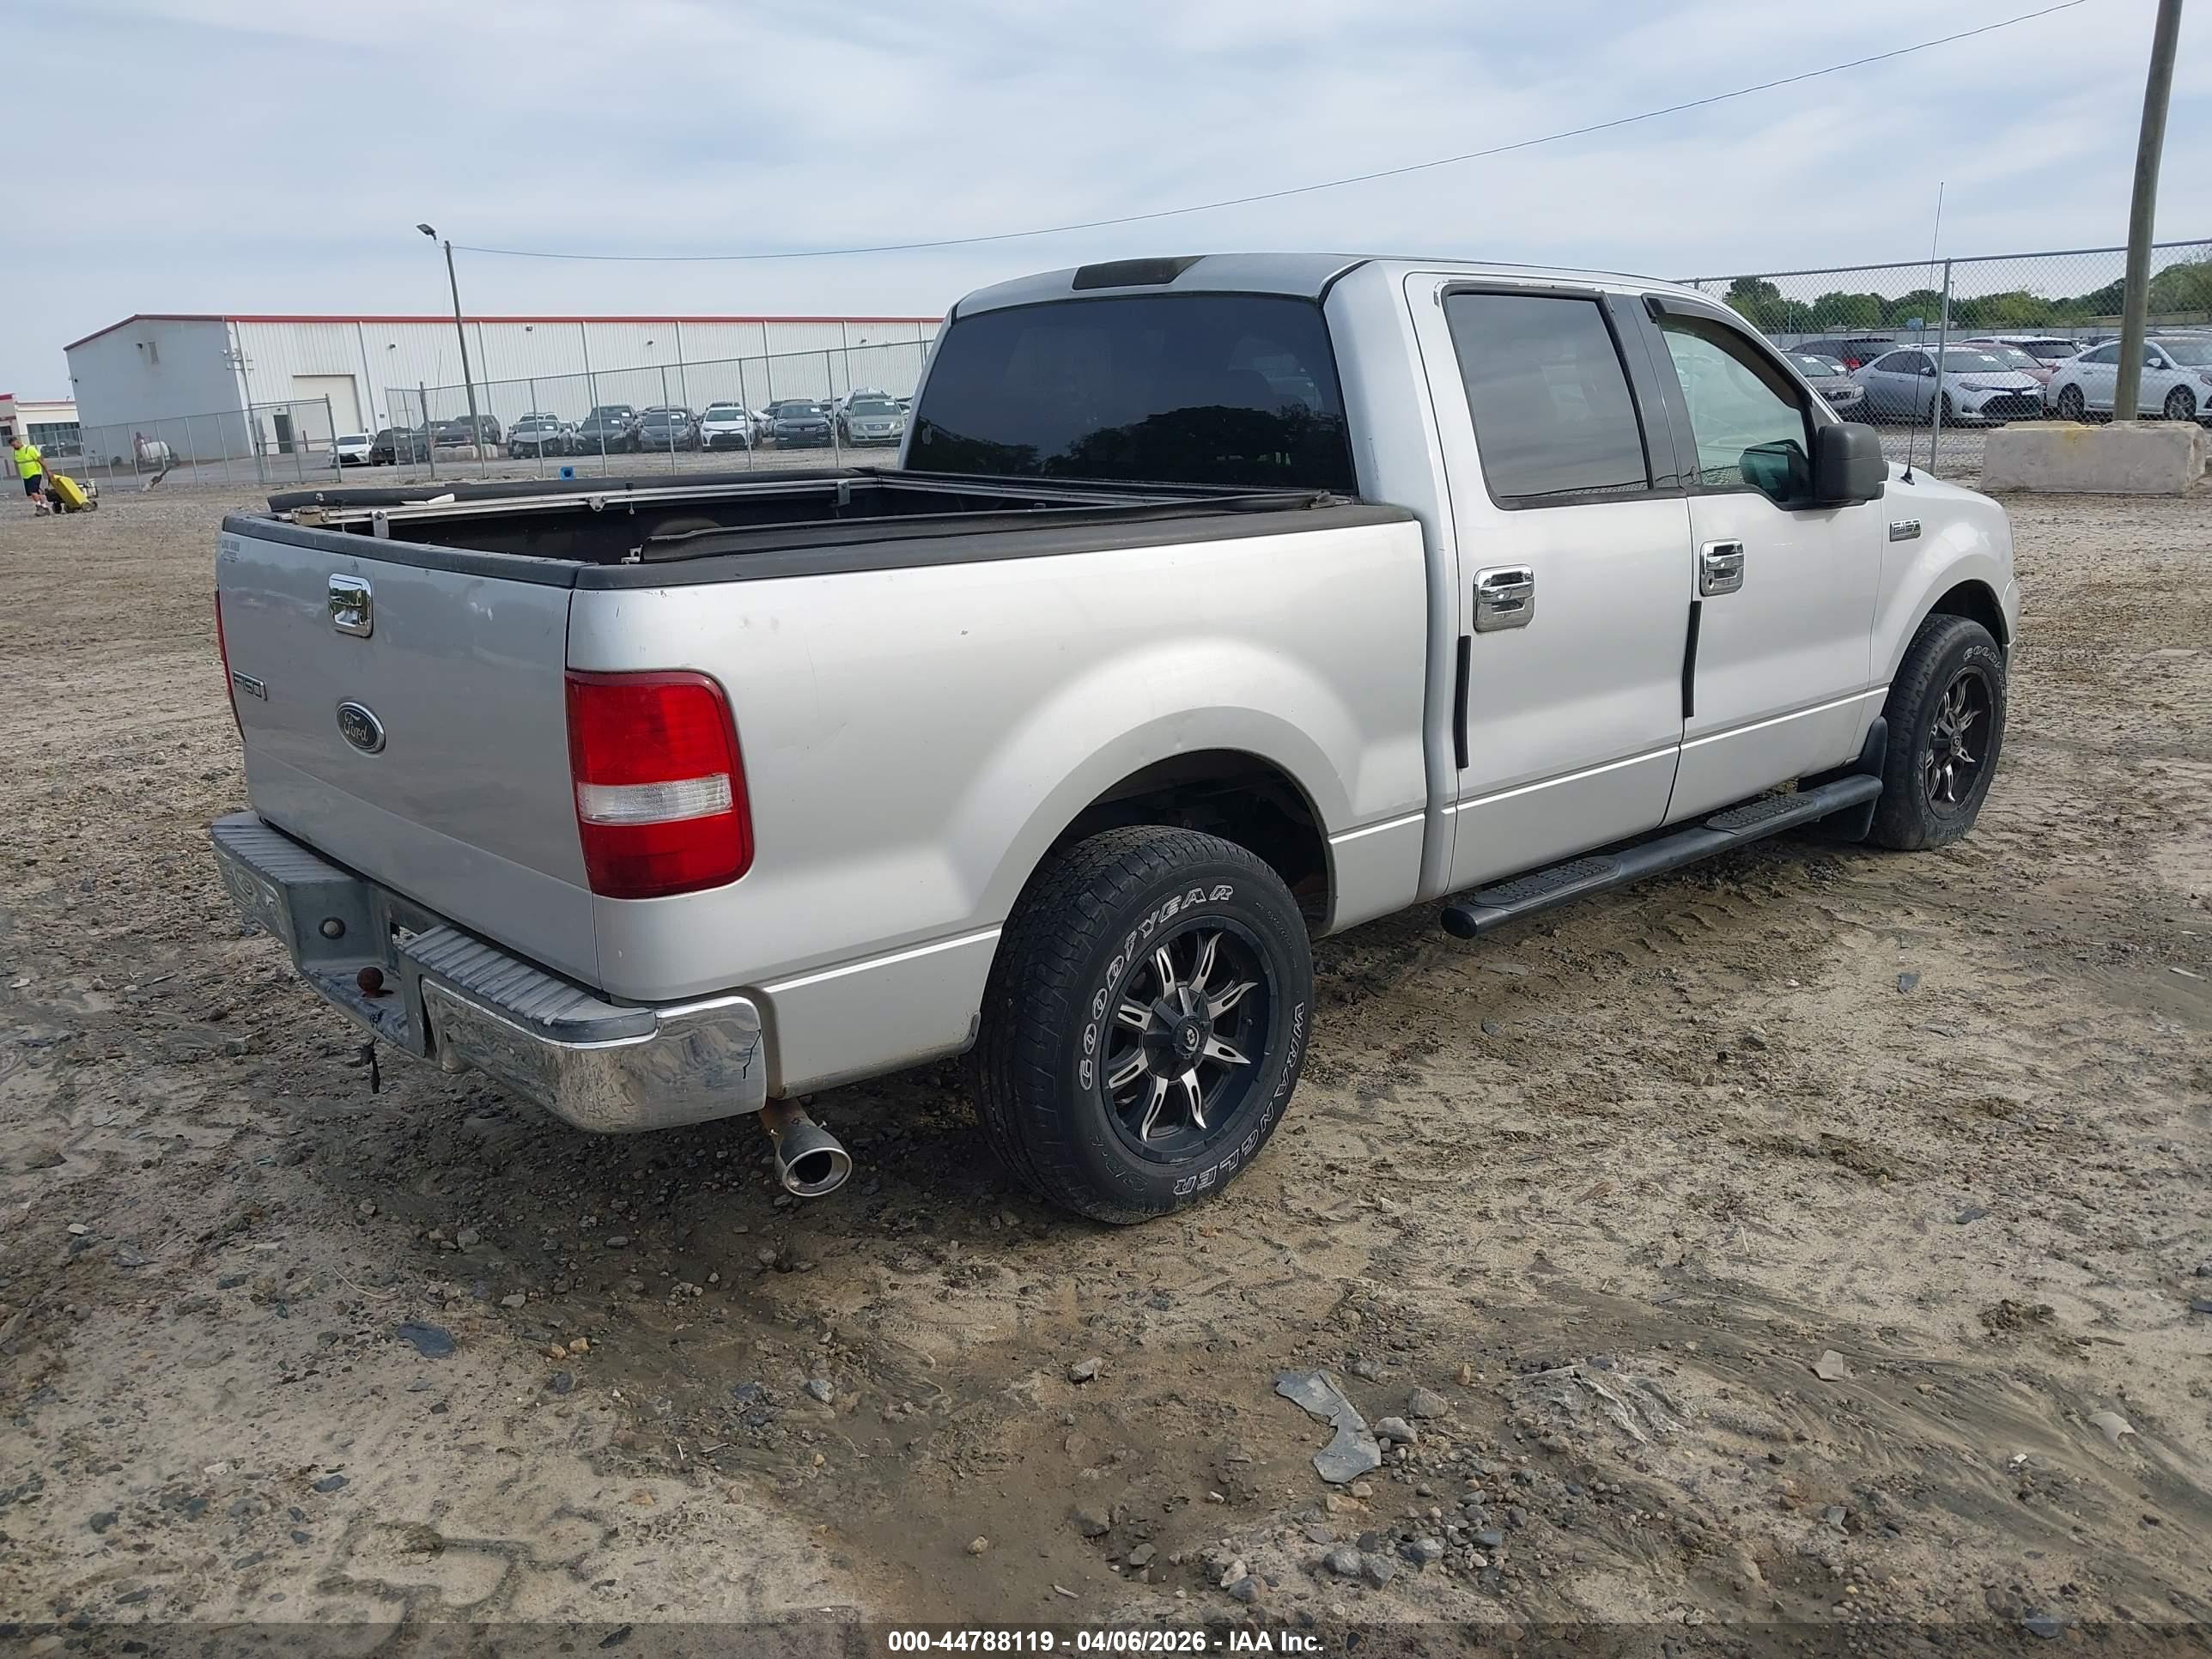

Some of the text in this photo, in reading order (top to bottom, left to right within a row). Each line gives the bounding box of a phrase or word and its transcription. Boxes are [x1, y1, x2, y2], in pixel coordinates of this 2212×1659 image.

[343, 711, 368, 743] Ford
[1079, 884, 1233, 1091] GOODYEAR
[1173, 1001, 1304, 1195] WRANGLER
